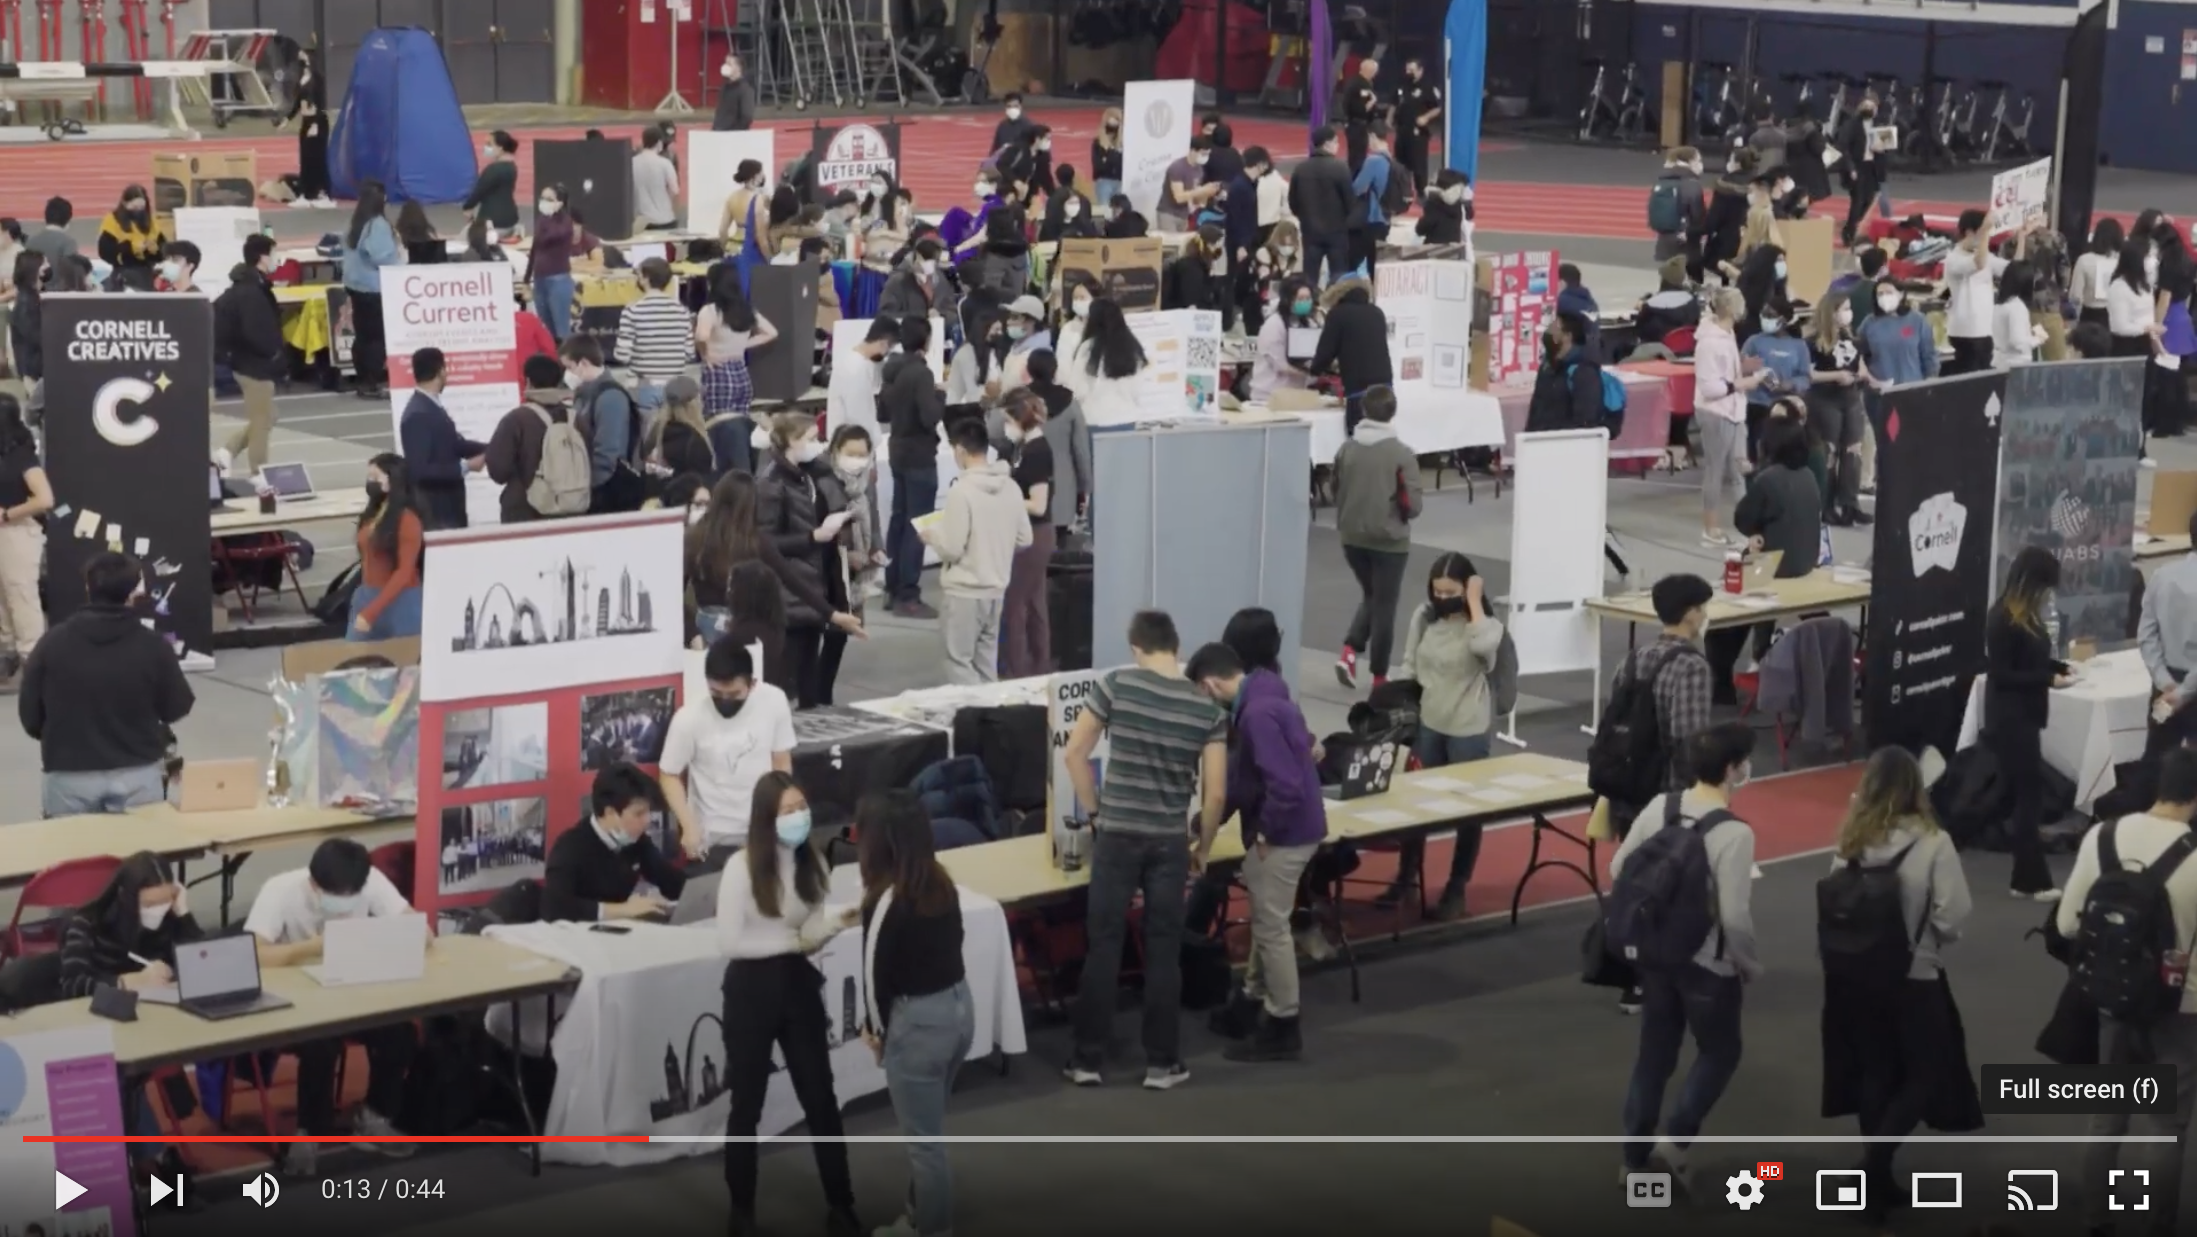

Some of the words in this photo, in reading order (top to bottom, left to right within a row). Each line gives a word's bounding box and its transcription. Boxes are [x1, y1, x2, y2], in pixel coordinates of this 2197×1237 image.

[404, 271, 493, 299] Cornell
[402, 301, 499, 325] Current
[75, 319, 172, 340] CORNELL
[67, 340, 181, 362] CREATIVES
[1915, 520, 1958, 552] Cornell
